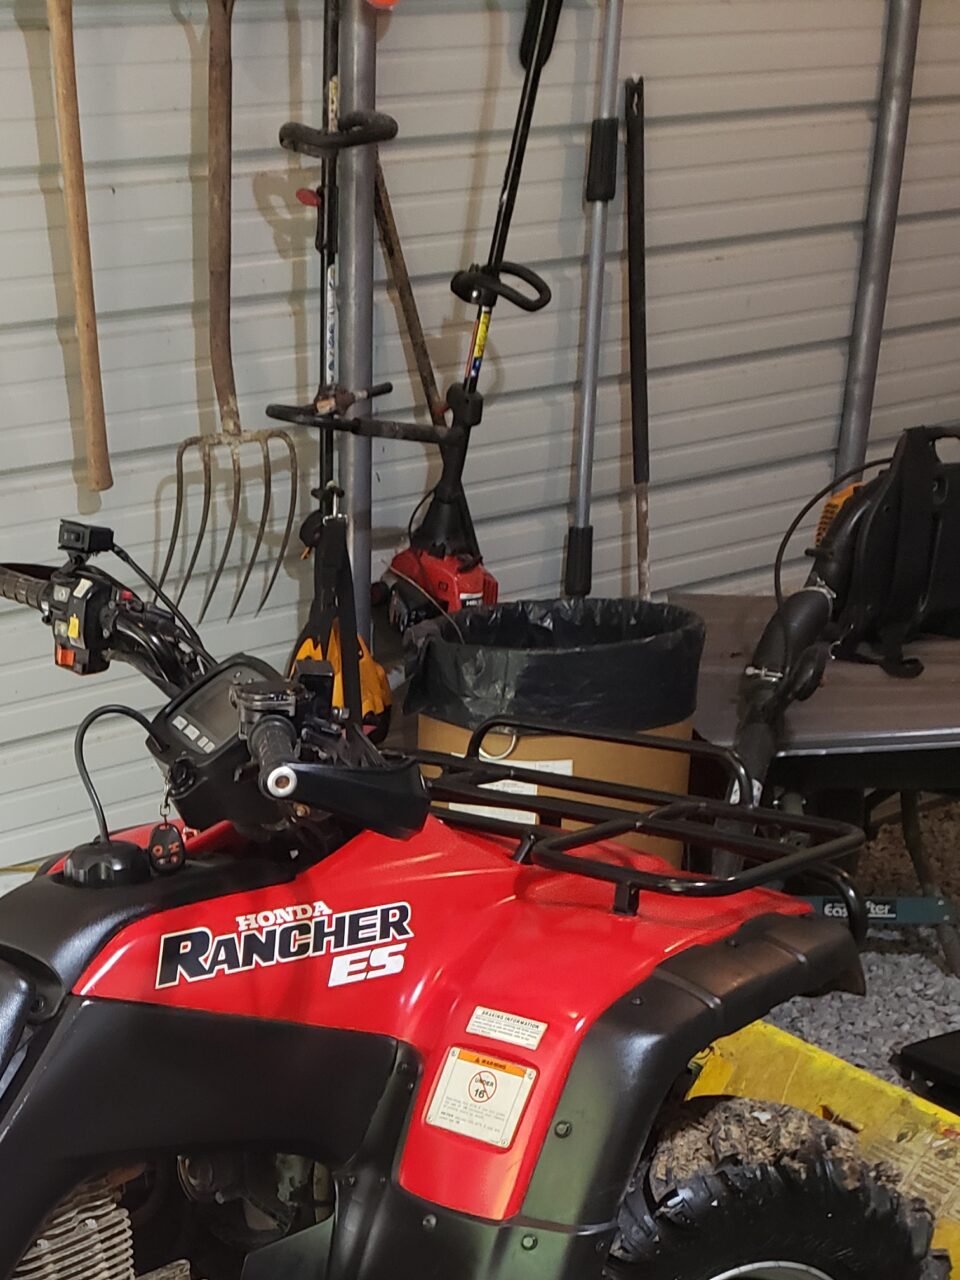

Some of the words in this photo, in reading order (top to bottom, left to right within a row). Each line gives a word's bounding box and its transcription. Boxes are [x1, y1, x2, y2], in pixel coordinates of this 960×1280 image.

[236, 900, 333, 931] HONDA
[154, 901, 415, 989] RANCHER
[328, 943, 407, 987] ES
[504, 1016, 540, 1030] INFORMATION
[481, 1059, 507, 1070] WARNING
[473, 1088, 485, 1099] 16
